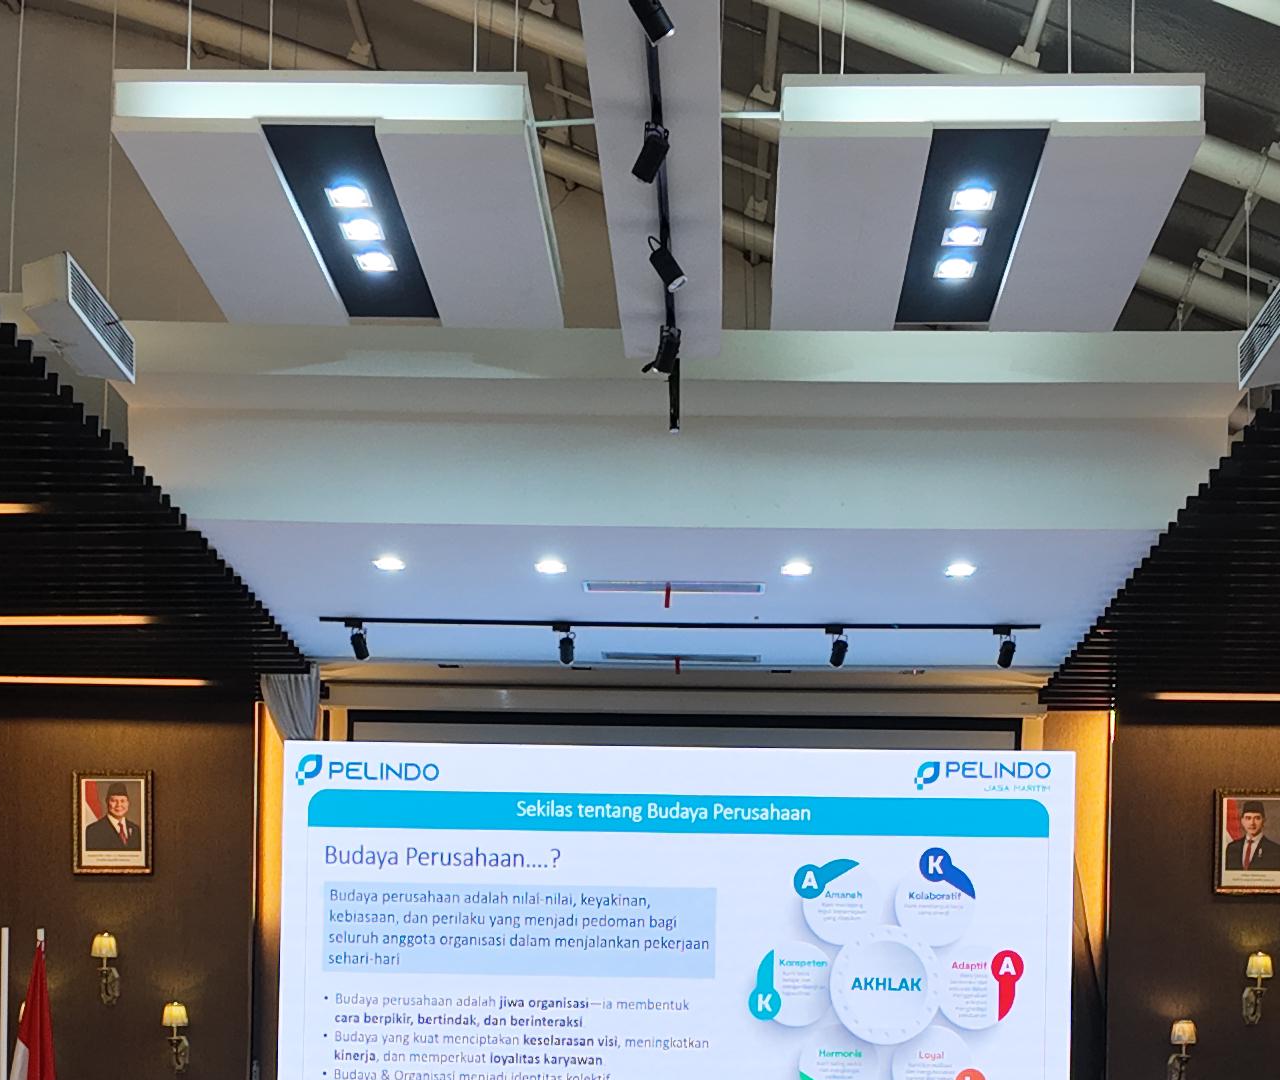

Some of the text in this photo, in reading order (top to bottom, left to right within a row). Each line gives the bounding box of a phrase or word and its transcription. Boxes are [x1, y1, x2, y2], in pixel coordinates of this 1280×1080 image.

[329, 761, 440, 781] PELINDO
[945, 761, 1052, 779] PELINDO
[516, 800, 811, 823] Sekilas tentang Budaya Perusahaan
[325, 845, 398, 869] Budaya
[928, 855, 944, 875] K
[801, 870, 819, 890] A
[330, 889, 378, 904] Budaya
[382, 890, 460, 904] perusahaan
[464, 891, 508, 904] adalah
[581, 893, 651, 909] keyakinan,
[329, 910, 677, 931] kebiasaan, dan perilaku yang menjadi pedoman bagi
[329, 931, 709, 952] seluruh anggota organisasi dalam menjalankan pekerjaan
[328, 952, 400, 965] sehari-hari
[998, 956, 1017, 976] A
[851, 977, 922, 992] AKHLAK
[335, 993, 378, 1007] Budaya
[382, 995, 452, 1008] perusahaan
[456, 995, 496, 1007] adalah
[498, 996, 524, 1009] jiwa
[616, 998, 689, 1011] membentuk
[757, 993, 773, 1012] K
[335, 1013, 583, 1027] cara berpikir, bertindak, dan berinteraksi
[334, 1031, 709, 1050] Budaya yang kuat menciptakan keselarasan visi, meningkatkan
[334, 1050, 603, 1067] kinerja, dan memperkuat loyalitas karyawan
[919, 1051, 945, 1061] Loyal
[381, 1069, 390, 1080] &
